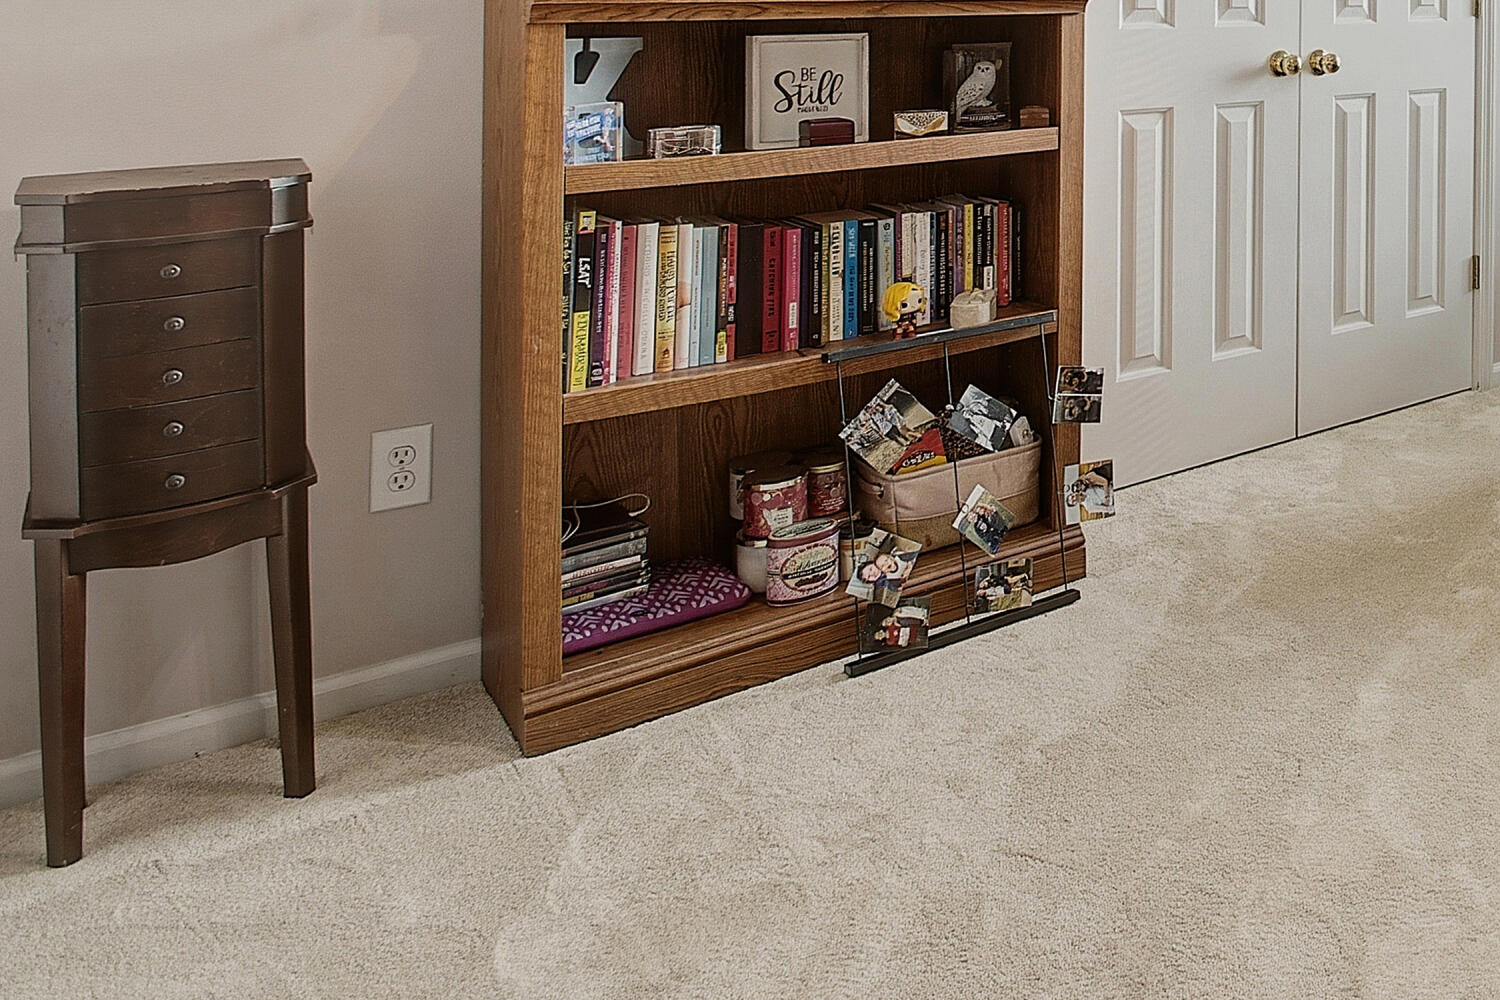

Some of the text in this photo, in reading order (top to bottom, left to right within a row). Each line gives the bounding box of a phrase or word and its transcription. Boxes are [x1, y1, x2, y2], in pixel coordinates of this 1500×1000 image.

[800, 66, 817, 82] BE
[773, 69, 844, 113] Still
[576, 257, 591, 288] LSAT
